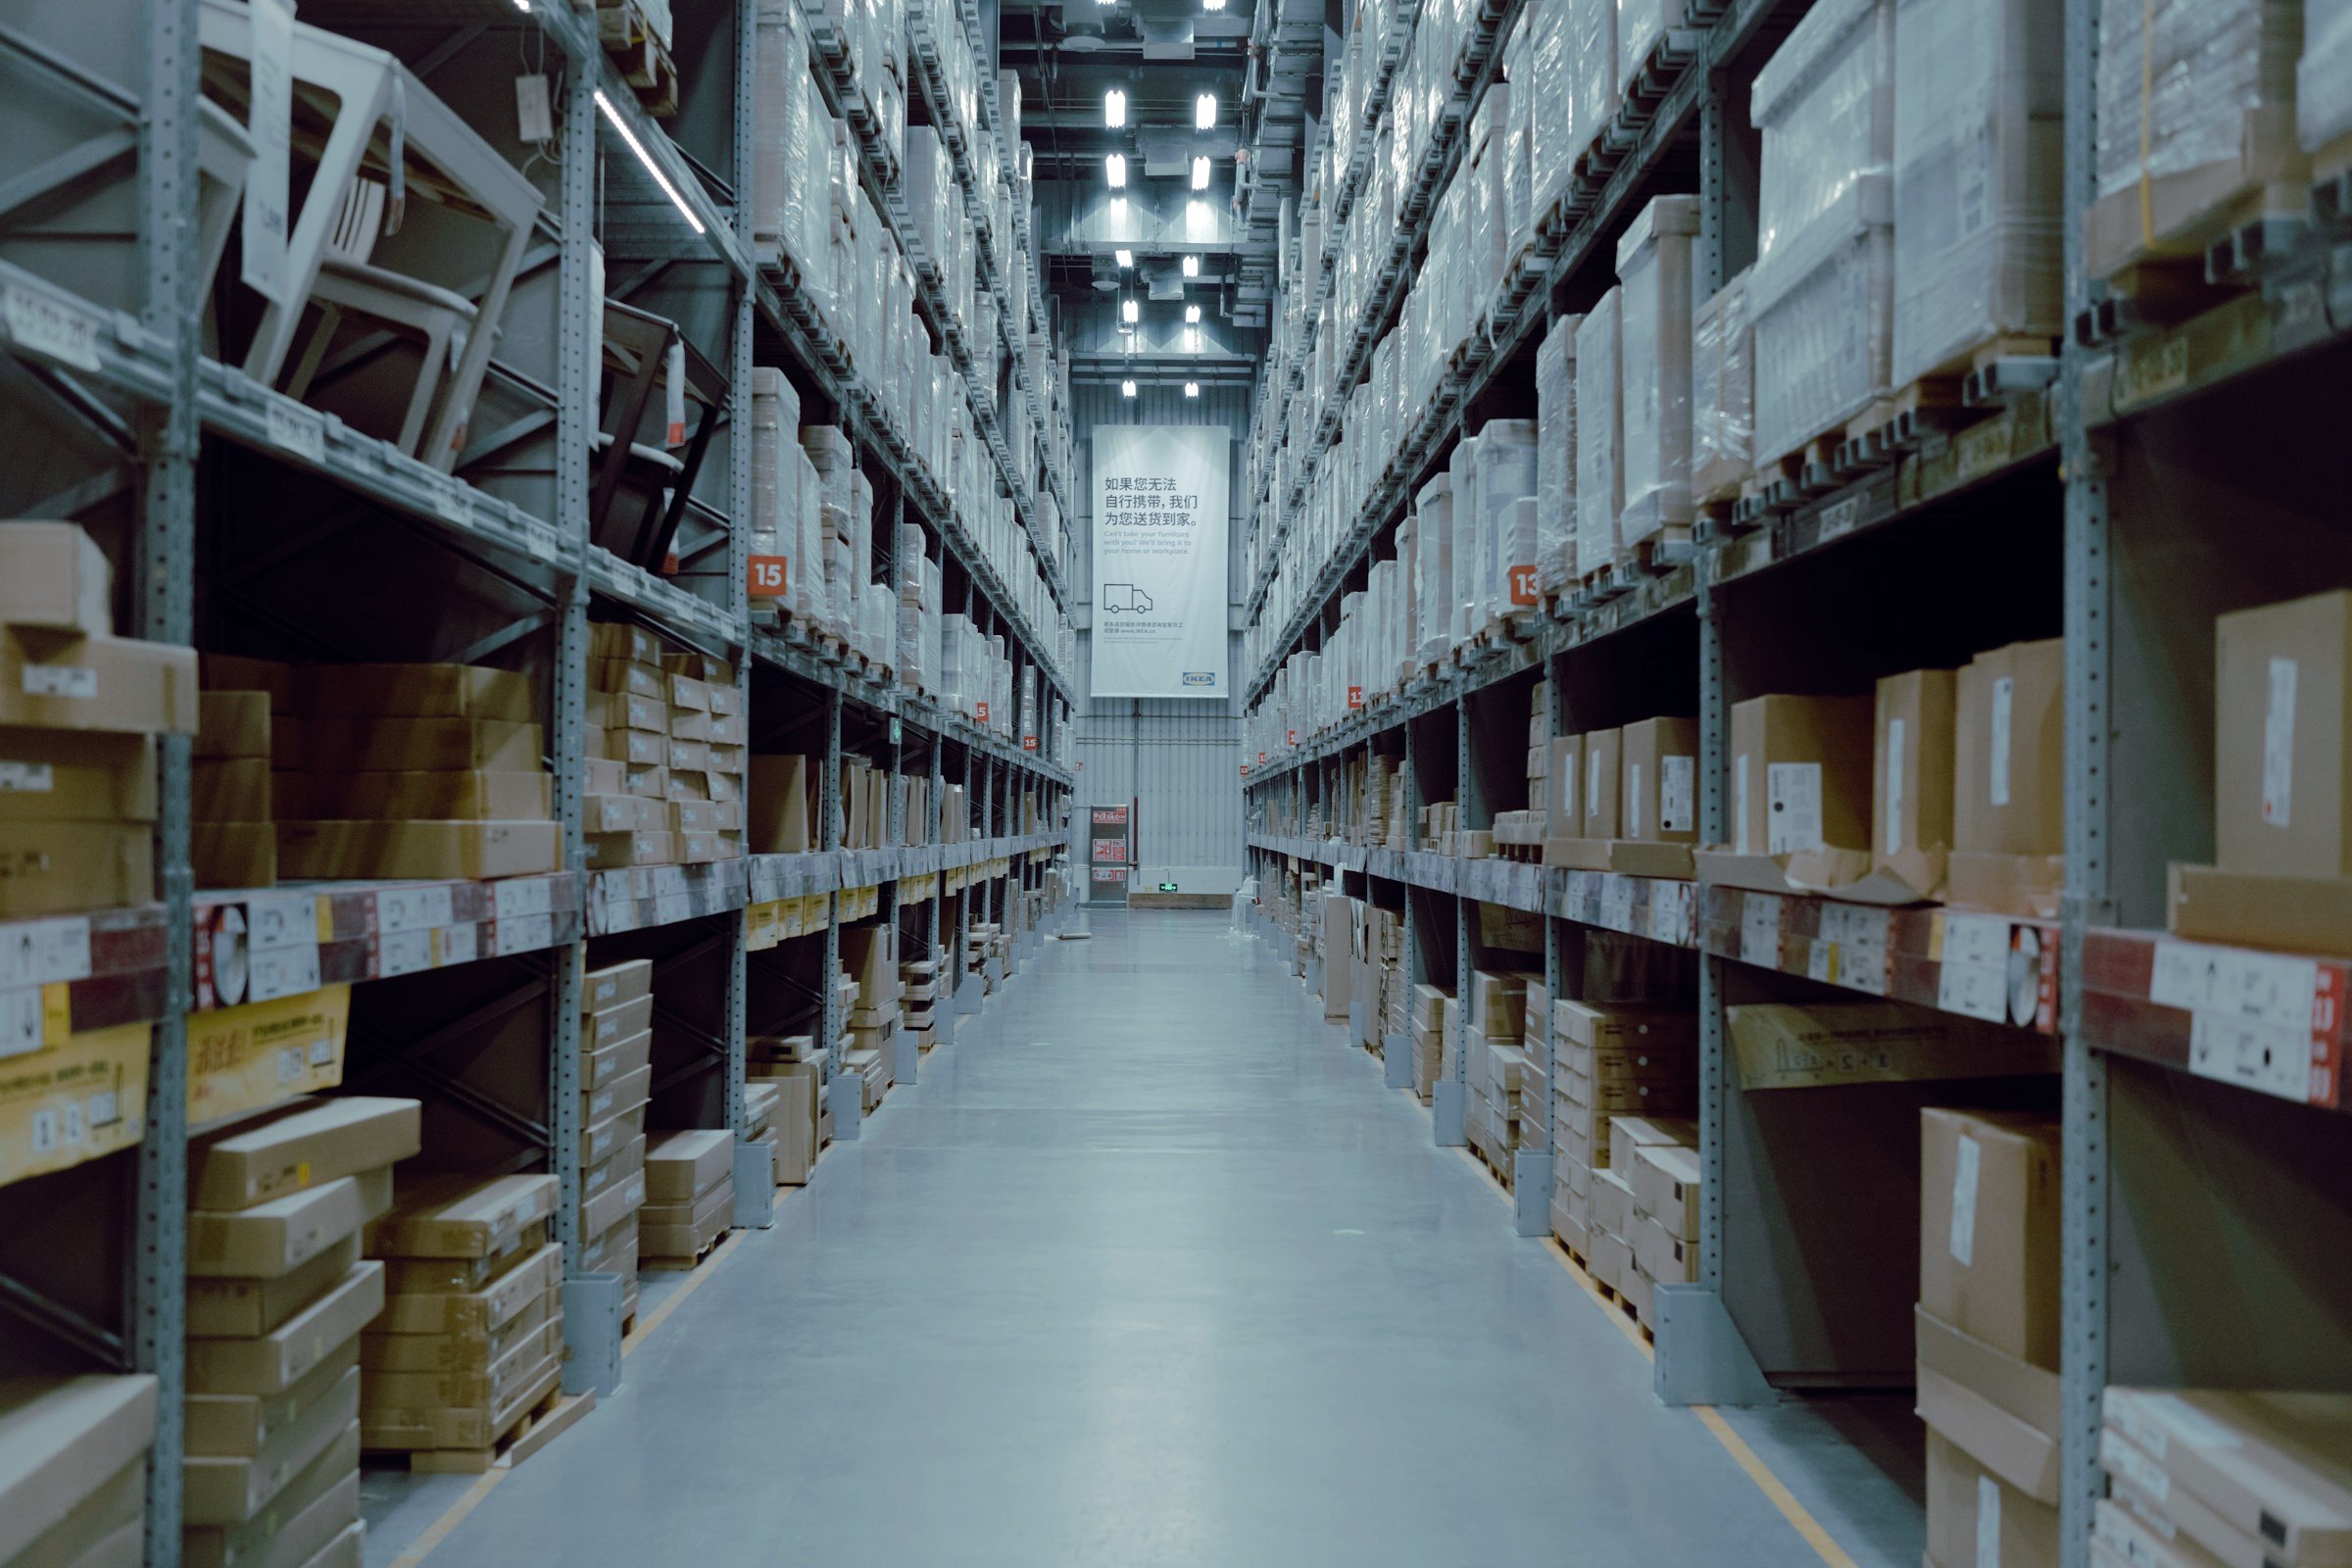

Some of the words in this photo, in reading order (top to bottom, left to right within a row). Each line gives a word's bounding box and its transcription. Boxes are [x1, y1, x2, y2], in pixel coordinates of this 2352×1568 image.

[1104, 476, 1177, 491] 如果您无法
[1105, 494, 1198, 510] 自行携带，我们
[1104, 512, 1197, 526] 为您送货到家。
[755, 563, 782, 587] 15
[978, 707, 987, 717] 5
